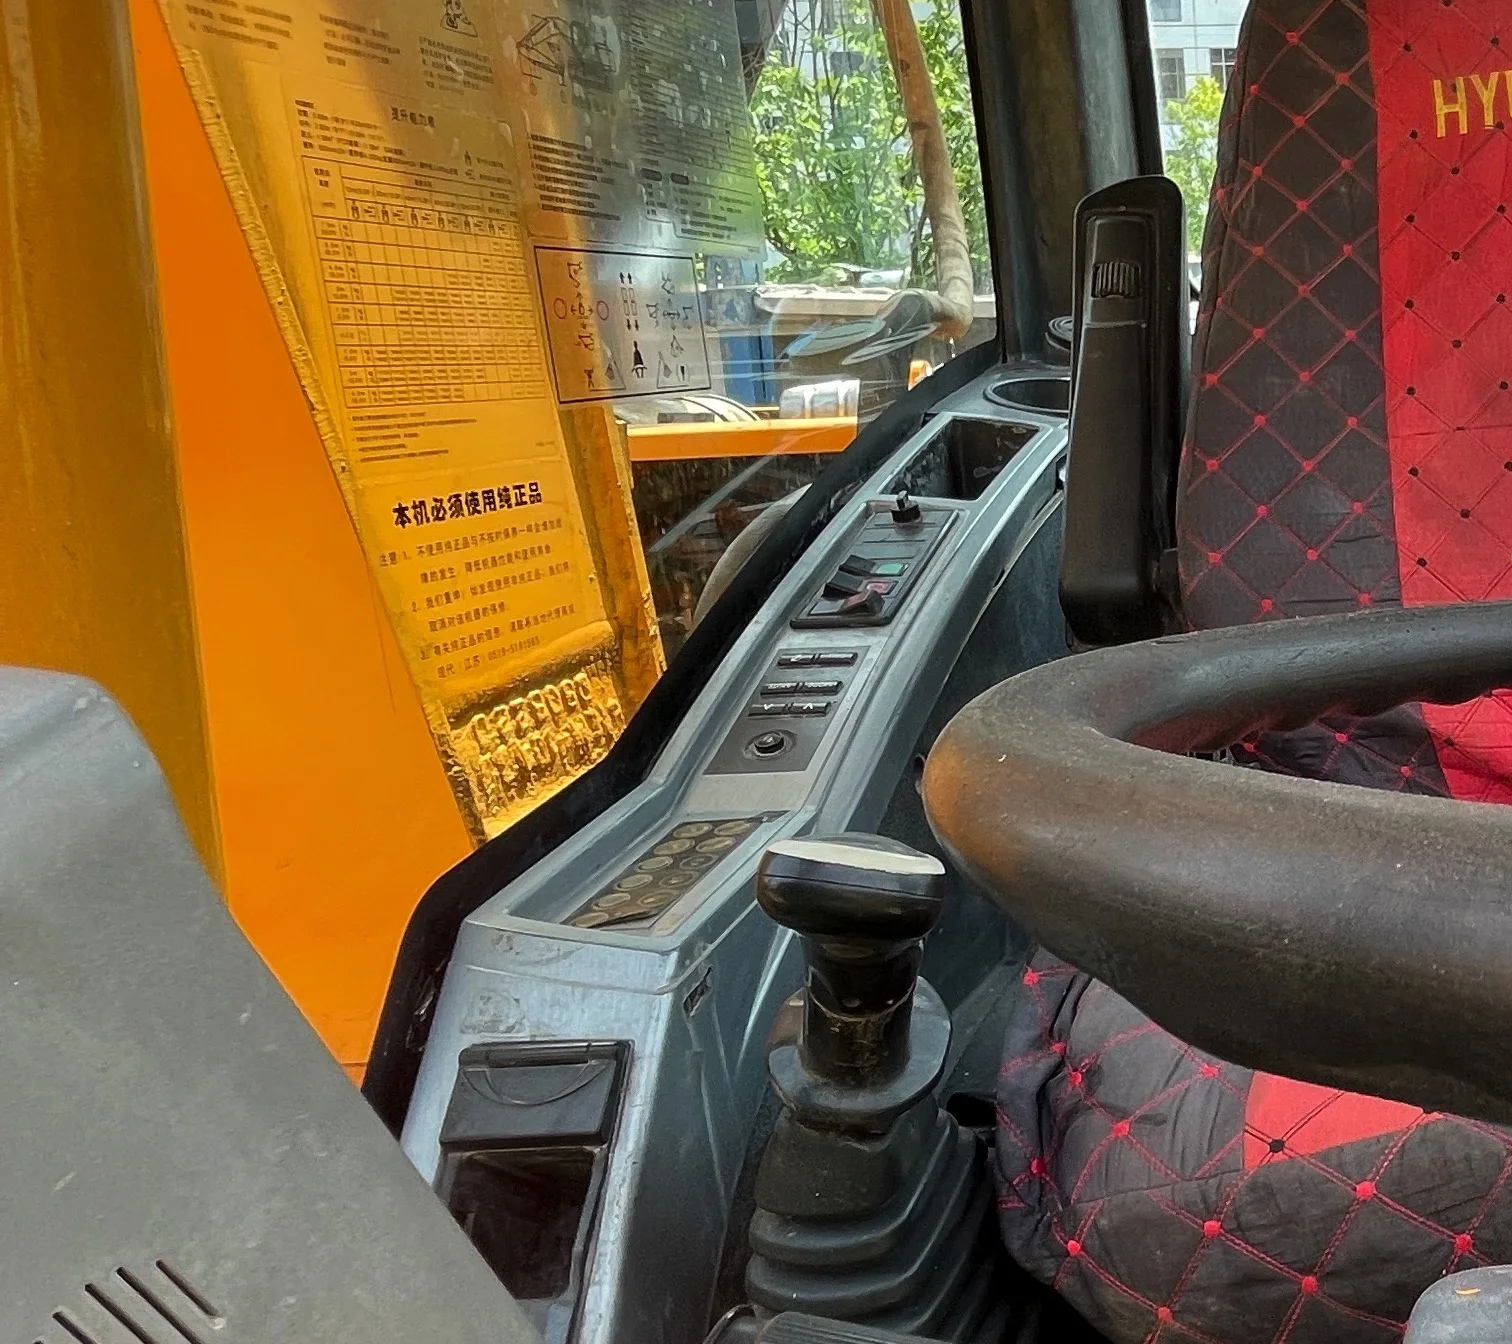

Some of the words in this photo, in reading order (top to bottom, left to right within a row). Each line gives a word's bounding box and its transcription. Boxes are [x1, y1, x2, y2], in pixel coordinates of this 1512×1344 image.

[392, 482, 542, 529] 本机必须使用纯正品
